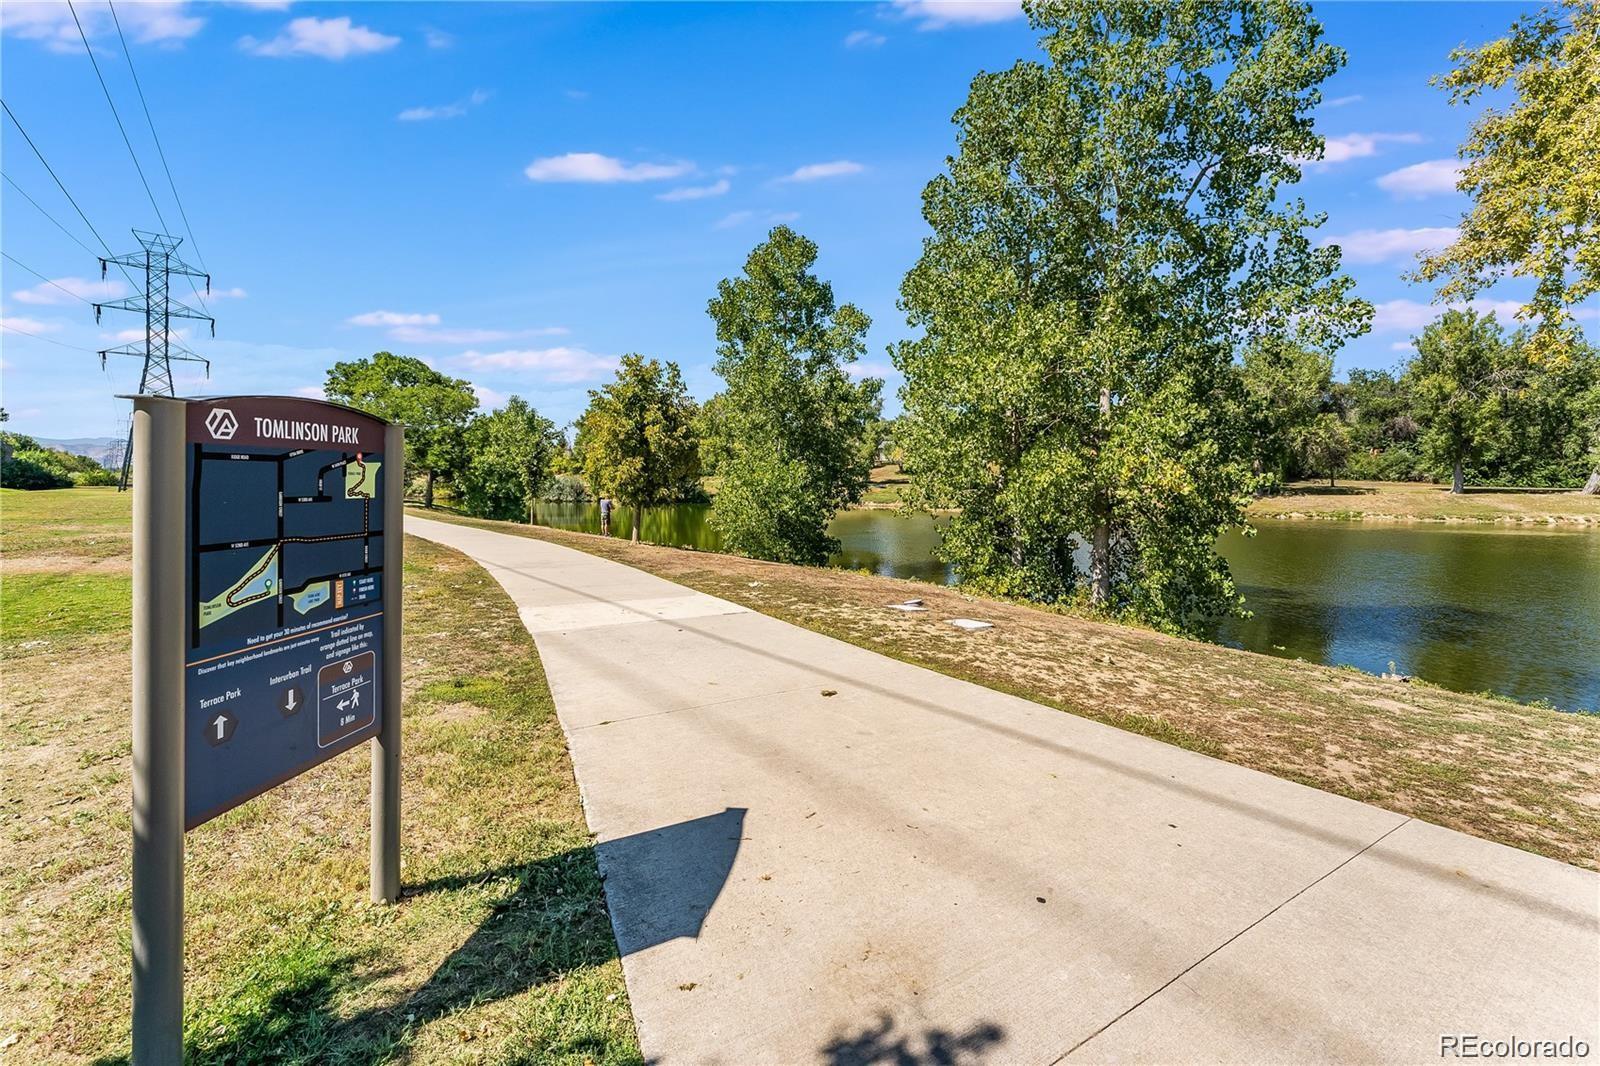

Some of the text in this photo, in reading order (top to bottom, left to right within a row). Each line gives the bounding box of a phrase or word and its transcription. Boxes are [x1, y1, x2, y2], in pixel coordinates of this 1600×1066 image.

[254, 417, 359, 444] TOMLINSON PARK
[331, 630, 340, 638] Trail
[340, 625, 359, 635] indicated
[247, 636, 260, 645] Need
[320, 642, 336, 652] orange
[336, 637, 350, 646] dotted
[198, 666, 216, 676] Discover
[217, 662, 226, 670] that
[235, 651, 264, 664] neighborhood
[264, 646, 284, 656] landmarks
[326, 651, 335, 660] and
[335, 648, 351, 657] signage
[270, 664, 312, 686] Interurban Trail
[331, 674, 364, 694] Terrace Park
[200, 688, 242, 709] Terrace Park
[340, 714, 356, 726] 8 Min
